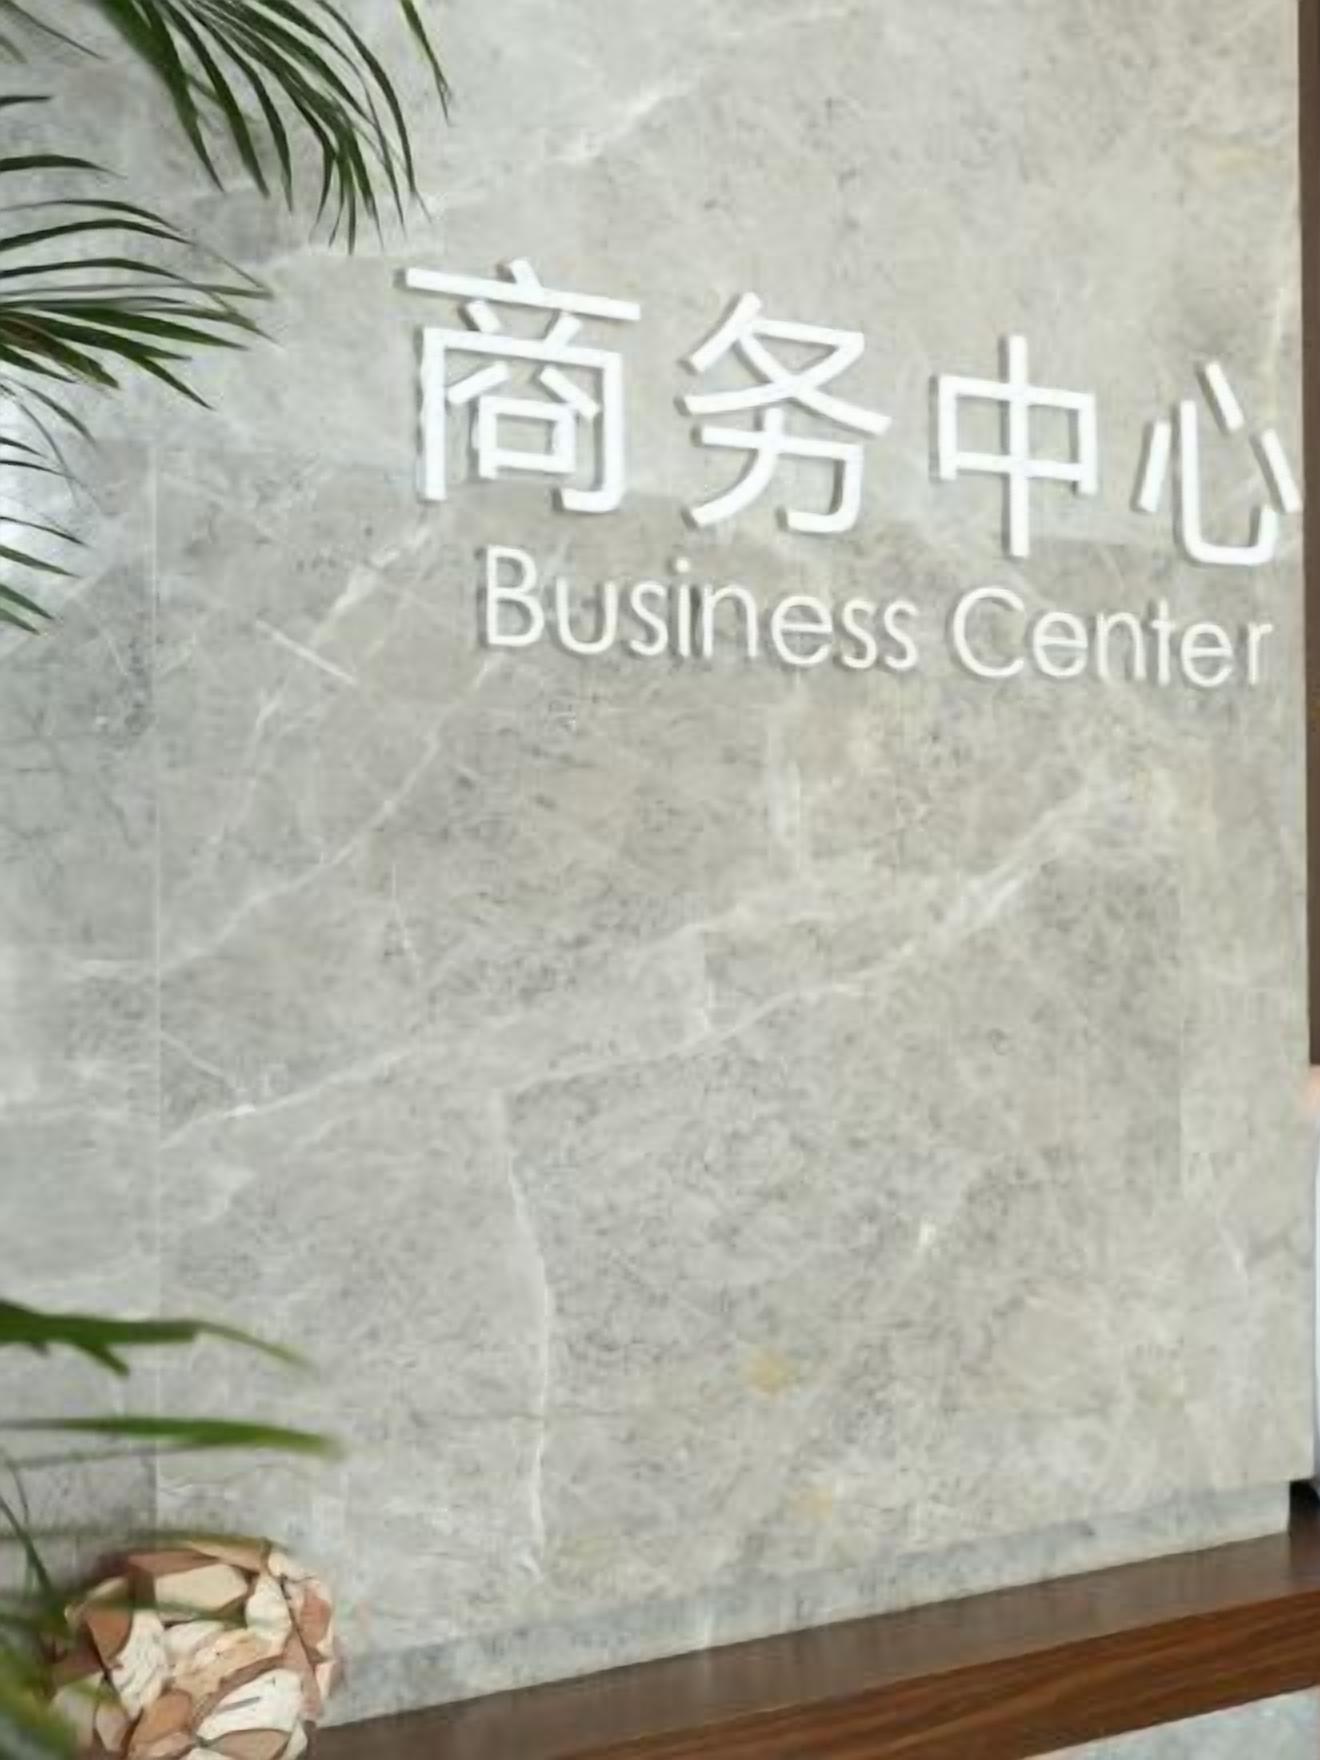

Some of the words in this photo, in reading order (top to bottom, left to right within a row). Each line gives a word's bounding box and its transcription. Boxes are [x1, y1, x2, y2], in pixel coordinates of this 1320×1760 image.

[402, 257, 1304, 568] 商务中心
[484, 545, 919, 670] Business
[950, 585, 1274, 689] Center
